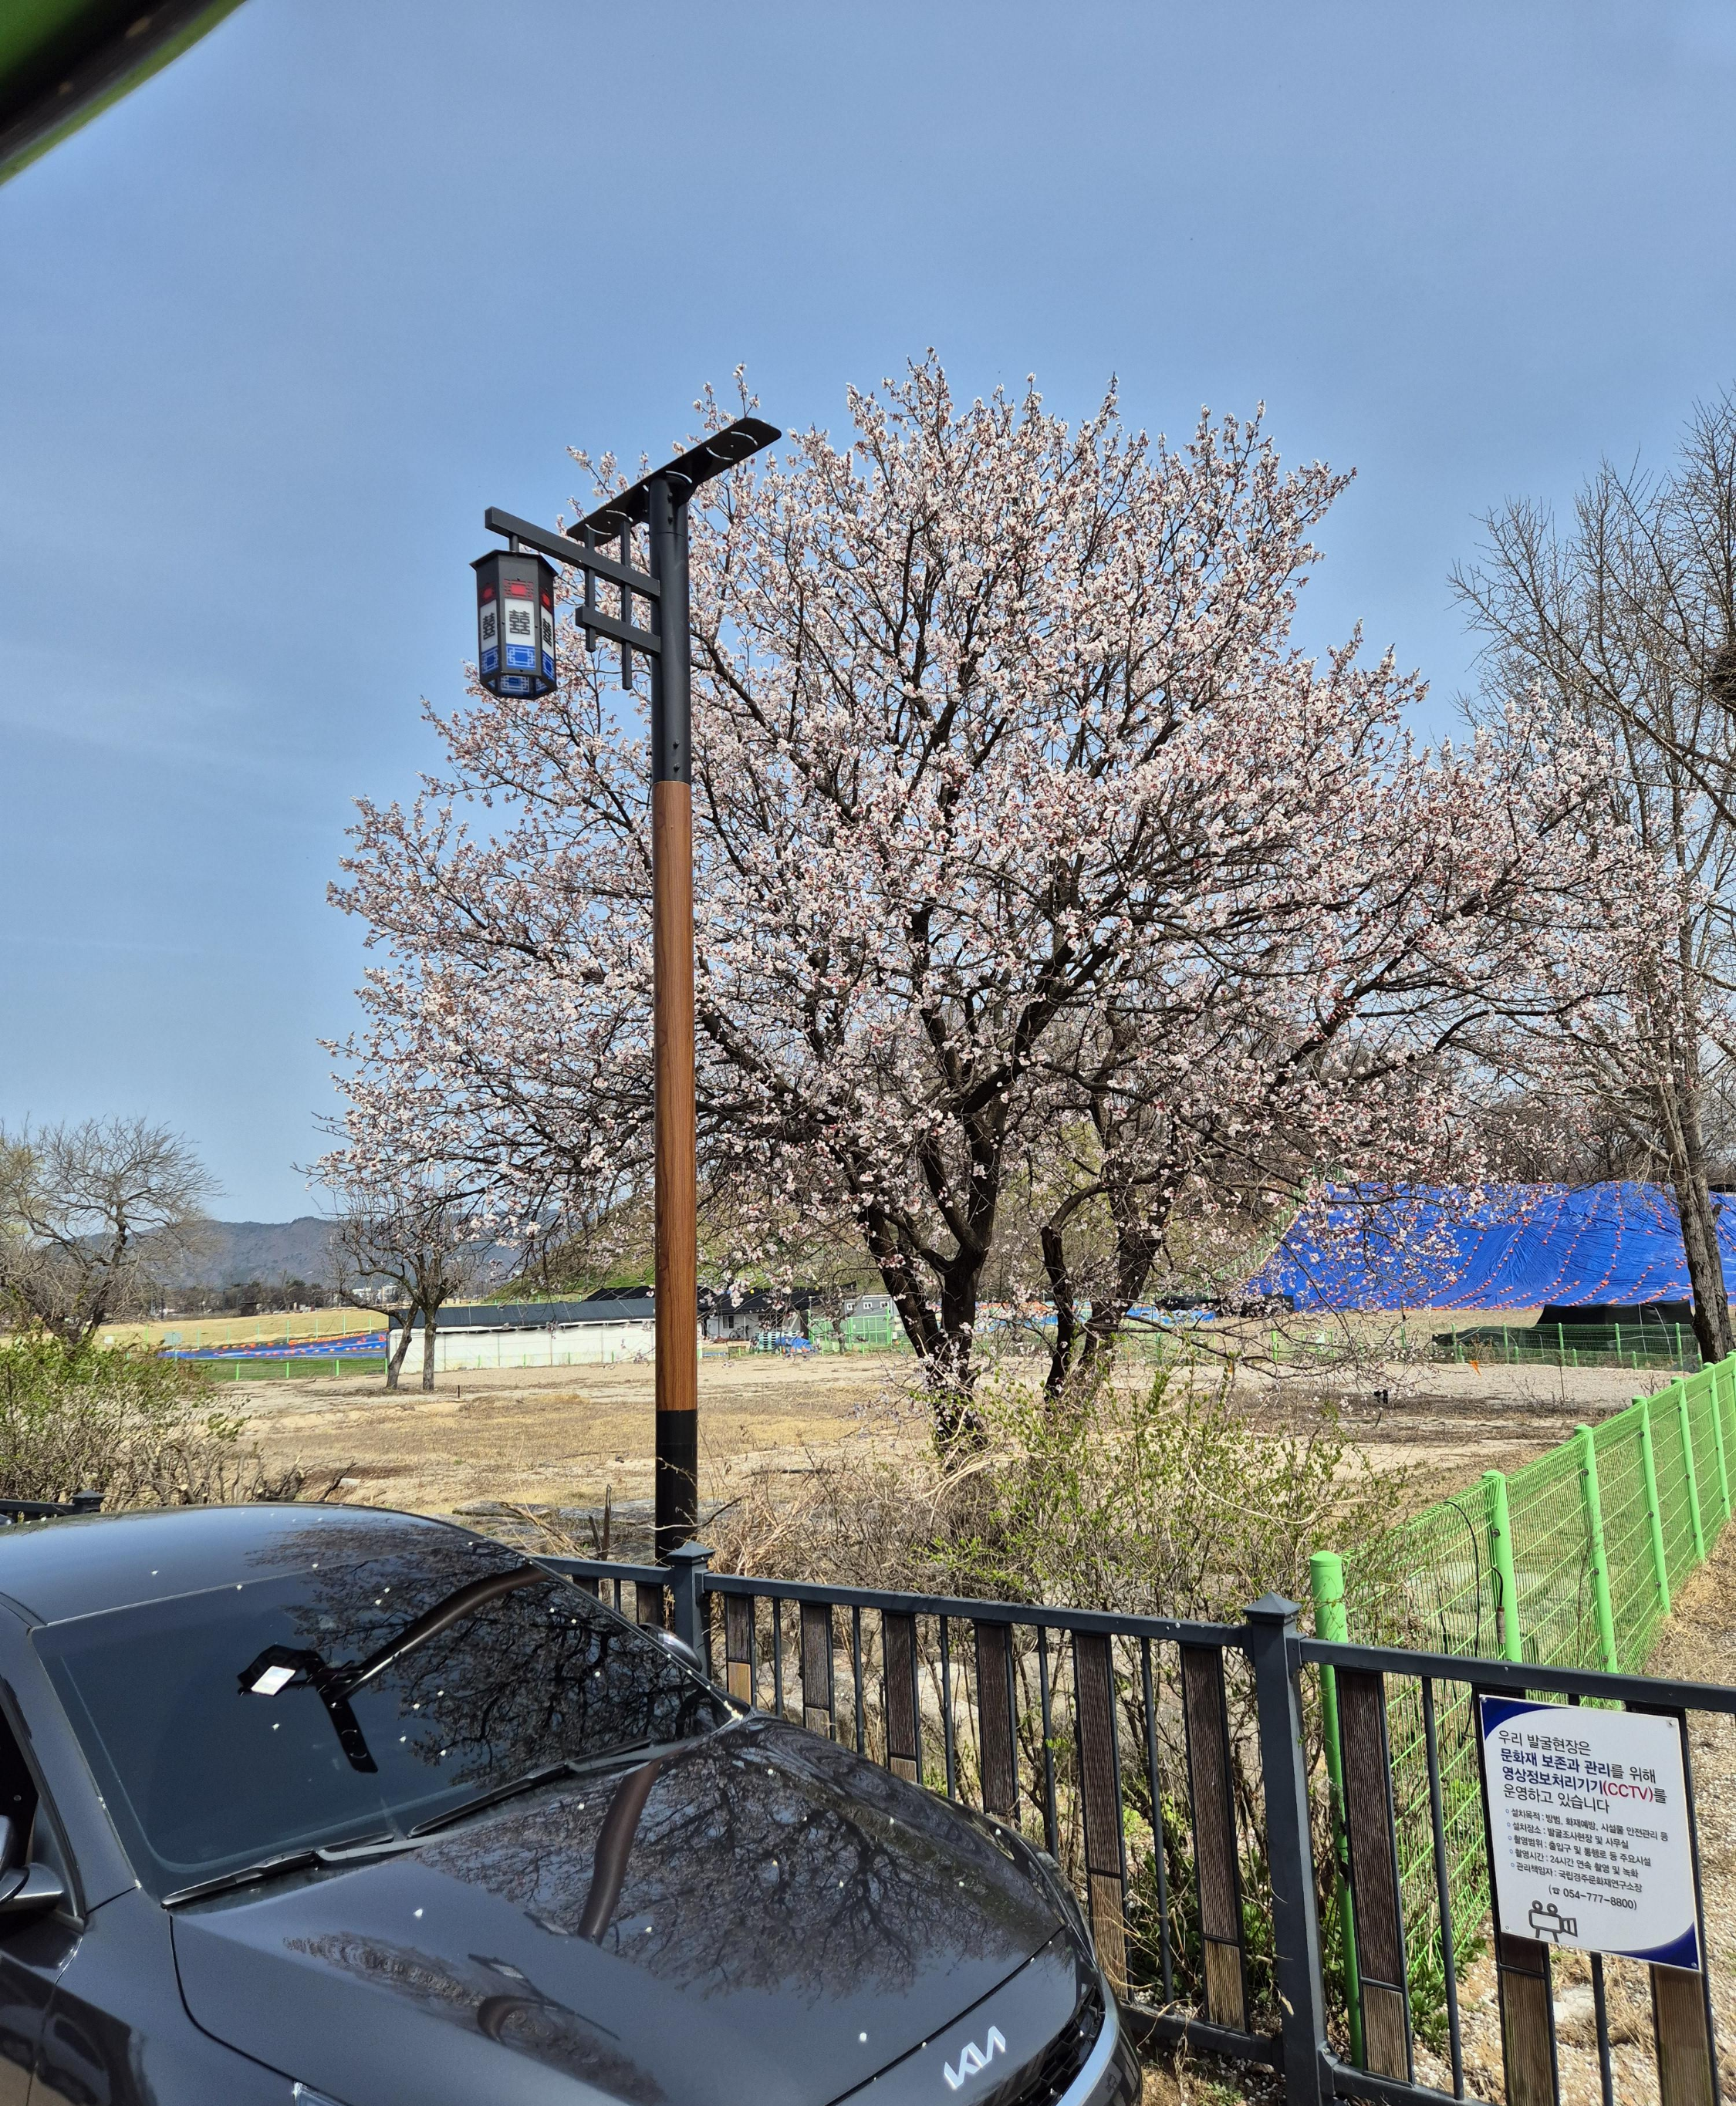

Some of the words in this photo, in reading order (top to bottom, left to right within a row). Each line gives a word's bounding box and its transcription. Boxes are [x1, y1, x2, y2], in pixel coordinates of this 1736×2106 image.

[1498, 1730, 1523, 1747] 우리
[1527, 1733, 1592, 1756] 발굴현장은
[1500, 1748, 1538, 1767] 문화재
[1542, 1753, 1580, 1773] 보존과
[1584, 1760, 1625, 1780] 관리를
[1629, 1766, 1657, 1784] 위해
[1502, 1766, 1667, 1804] 영상정보처리기기(CCTV)를
[1503, 1784, 1554, 1804] 운영하고
[1557, 1792, 1610, 1814] 있습니다
[1547, 1827, 1592, 1844] 발굴조사현장
[1595, 1835, 1603, 1845] 및
[1605, 1838, 1629, 1849] 사무실
[1601, 1823, 1624, 1835] 시설물
[1626, 1827, 1658, 1840] 안전관리
[1660, 1831, 1669, 1841] 등
[1549, 1841, 1572, 1853] 출입구
[1573, 1845, 1582, 1855] 및
[1584, 1847, 1607, 1859] 통행로
[1609, 1851, 1617, 1861] 등
[1619, 1853, 1652, 1867] 주요시설
[1549, 1855, 1575, 1868] 24시간
[1576, 1859, 1592, 1870] 연속
[1594, 1861, 1609, 1874] 촬영
[1612, 1865, 1620, 1875] 및
[1623, 1867, 1639, 1878] 녹화
[1559, 1869, 1643, 1893] 국립경주문화재연구소장
